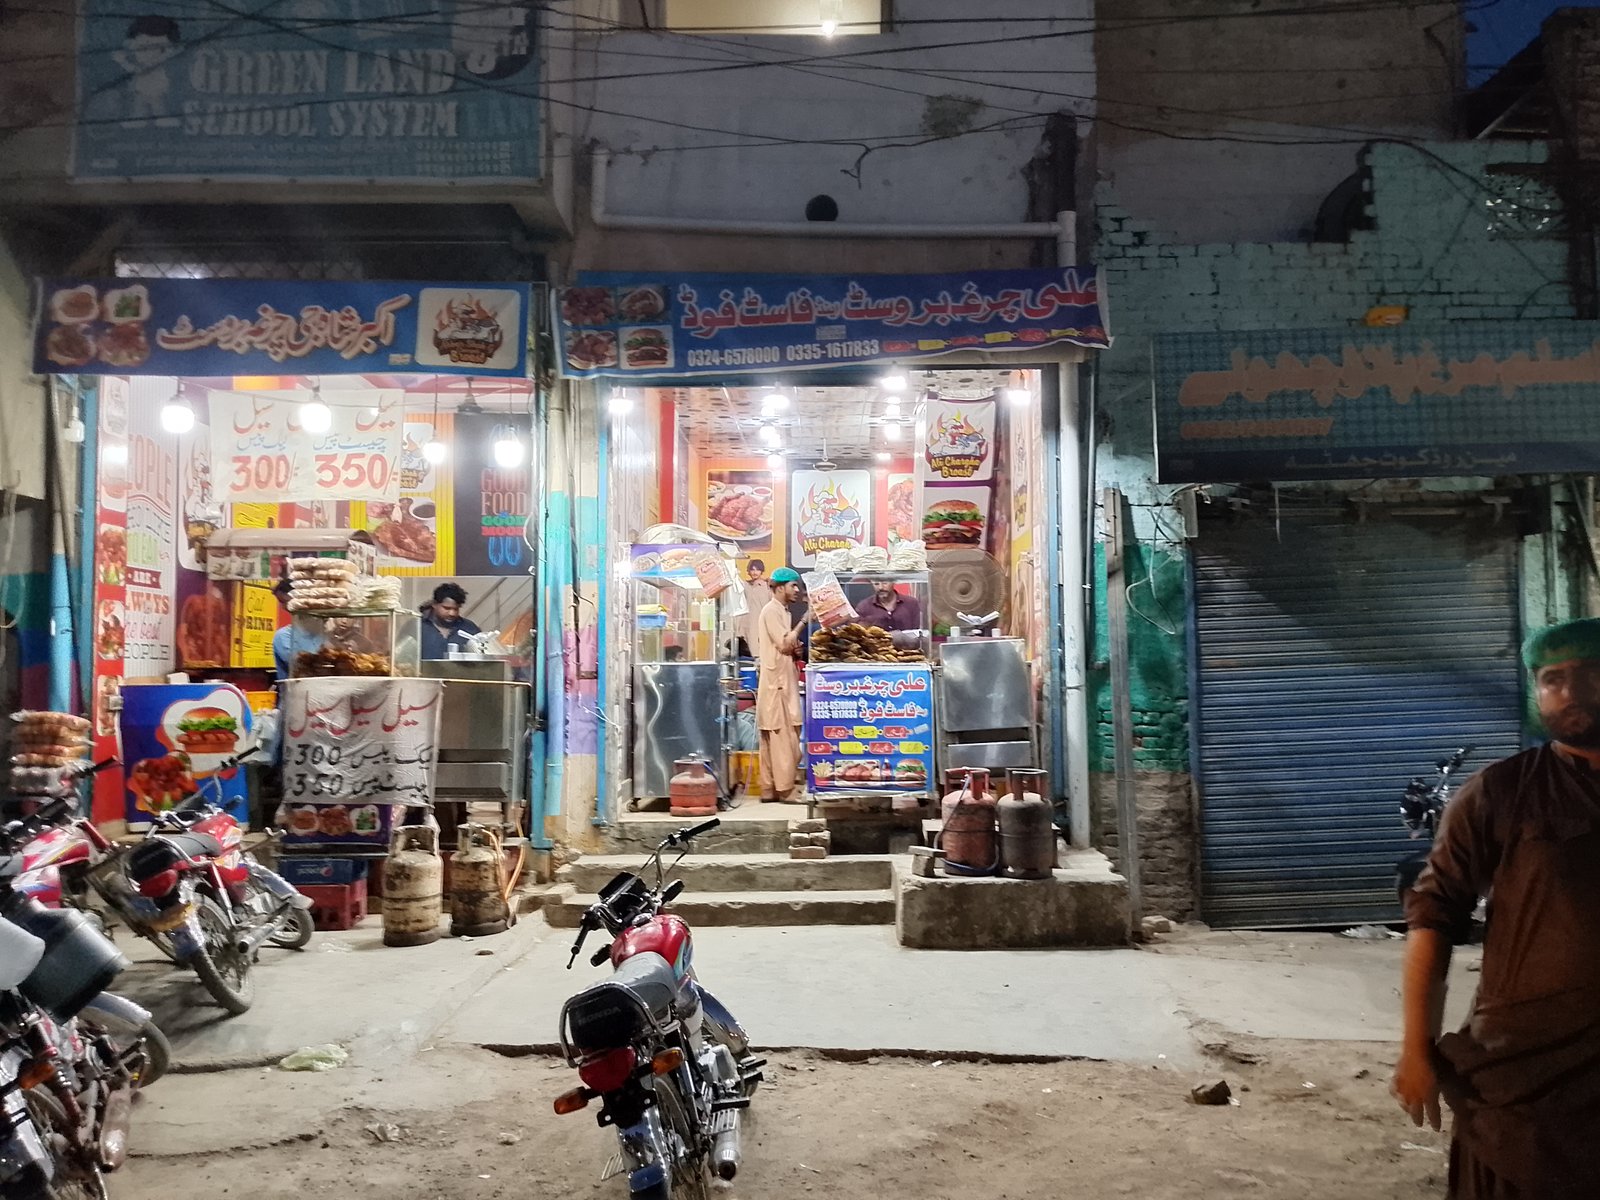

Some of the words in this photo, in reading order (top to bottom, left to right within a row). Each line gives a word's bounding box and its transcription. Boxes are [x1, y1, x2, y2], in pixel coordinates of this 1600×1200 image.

[189, 48, 329, 94] GREEN
[344, 48, 457, 95] LAND
[182, 101, 317, 137] SCHOOL
[328, 101, 459, 137] SYSTEM
[678, 282, 738, 340] فوڈ
[738, 287, 817, 328] فاسٹ
[687, 345, 780, 368] 0324-6578000
[786, 339, 880, 363] 0335-1617833
[481, 468, 528, 491] GOOD
[941, 466, 973, 478] Broast
[481, 491, 528, 516] FOOD
[803, 537, 818, 552] Ali
[888, 672, 928, 698] علی
[858, 697, 884, 723] فوڈ
[884, 700, 916, 719] فاسٹ
[578, 1005, 621, 1026] HONDA
